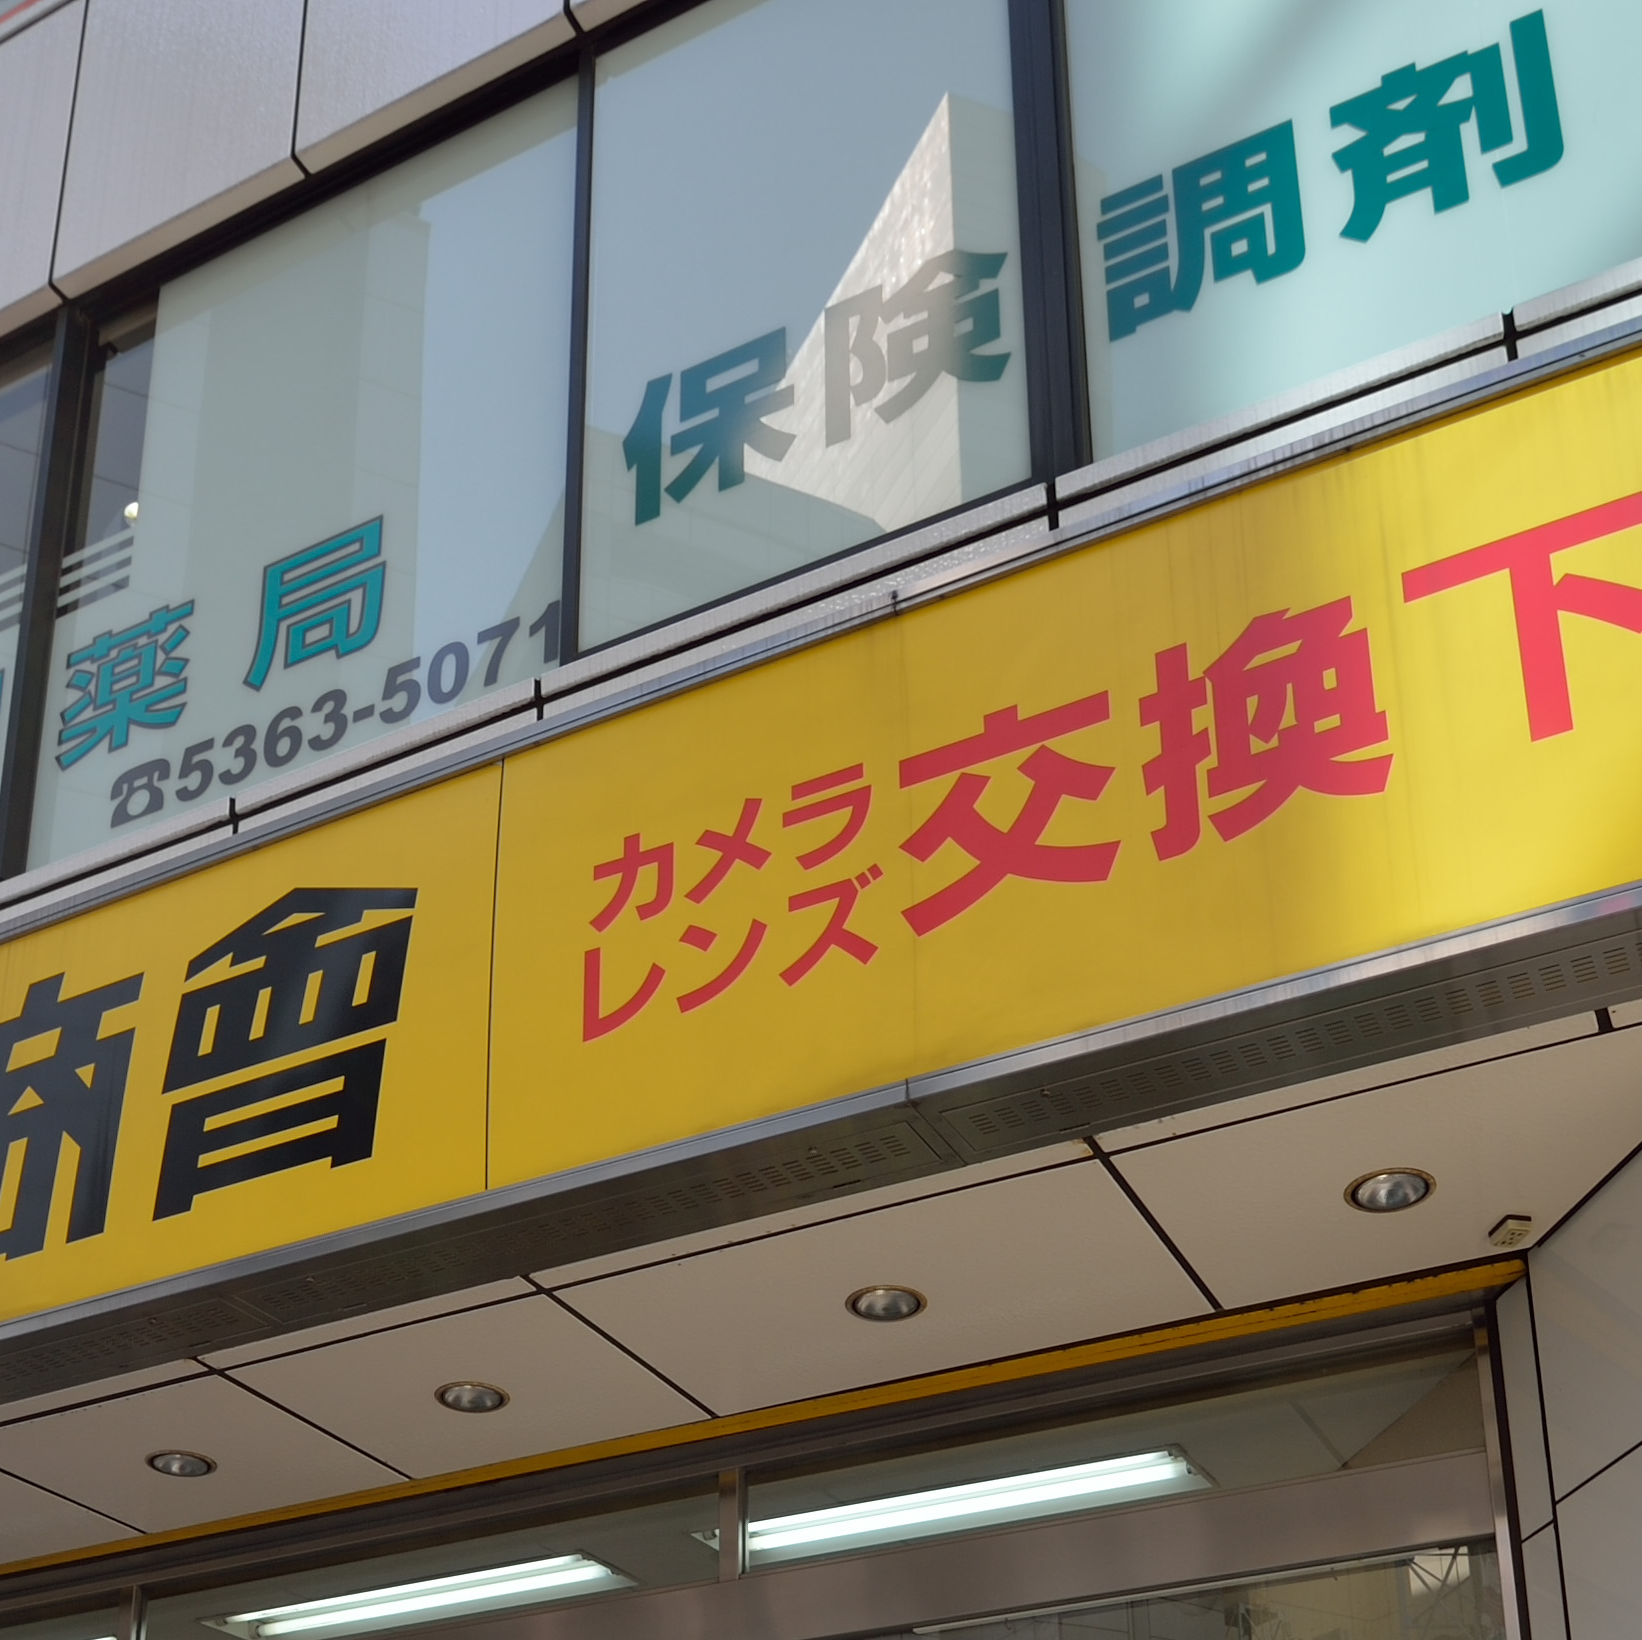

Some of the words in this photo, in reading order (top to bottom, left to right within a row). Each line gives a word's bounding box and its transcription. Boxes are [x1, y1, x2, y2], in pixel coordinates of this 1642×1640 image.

[622, 8, 1565, 526] 保険調剤
[174, 600, 563, 805] 5363-5071
[591, 764, 876, 934] カメラ
[580, 870, 880, 1042] レンズ
